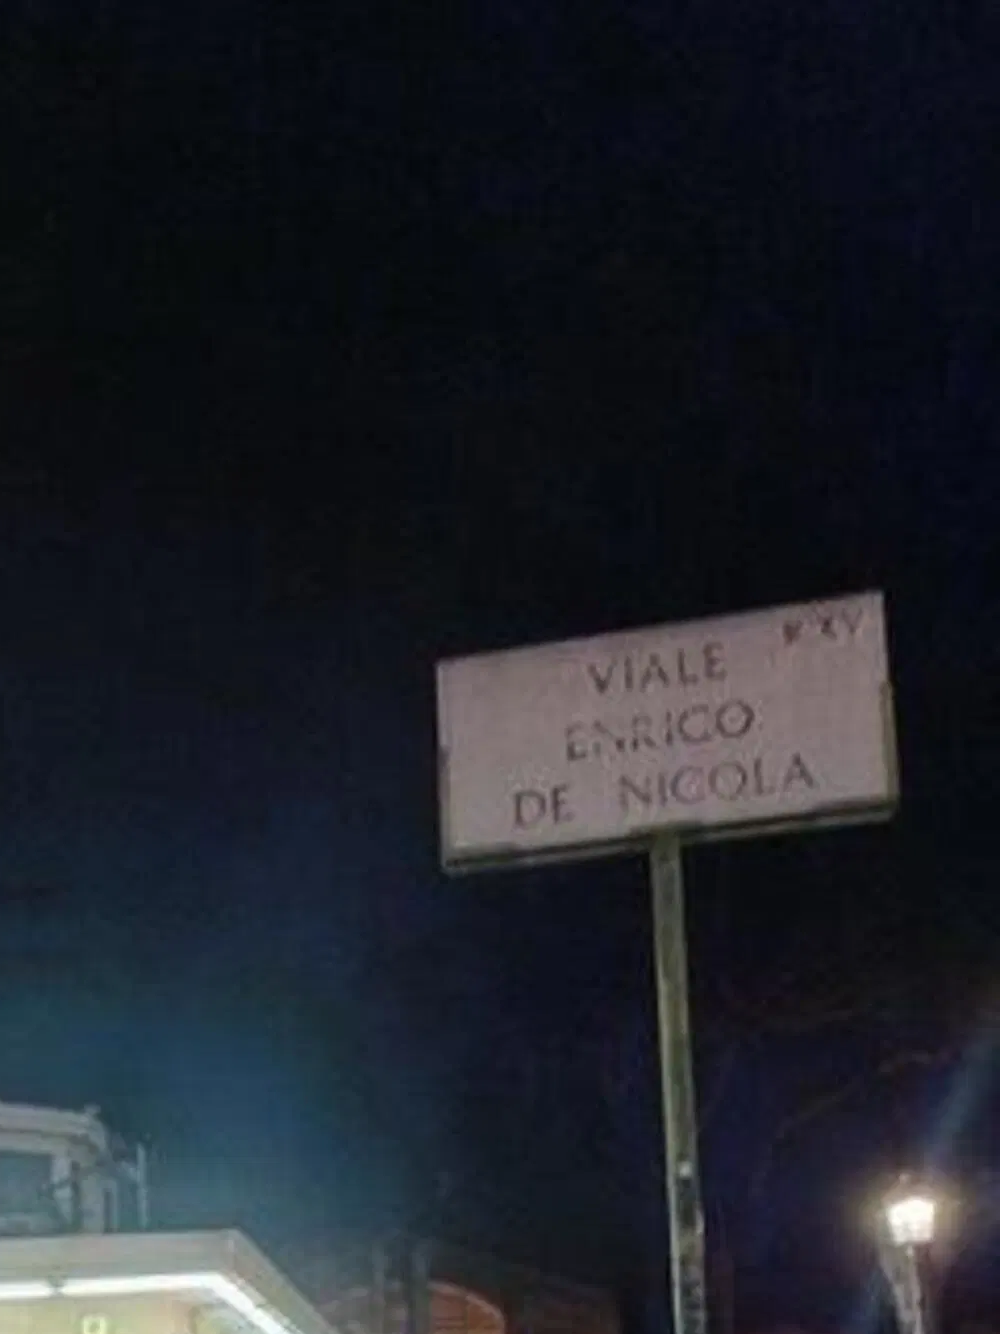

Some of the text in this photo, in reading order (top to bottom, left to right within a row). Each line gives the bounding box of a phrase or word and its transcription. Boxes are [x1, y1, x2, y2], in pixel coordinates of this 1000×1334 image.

[586, 642, 728, 693] VIALE
[564, 699, 755, 762] ENRICO
[512, 752, 814, 828] DE NICOLA
